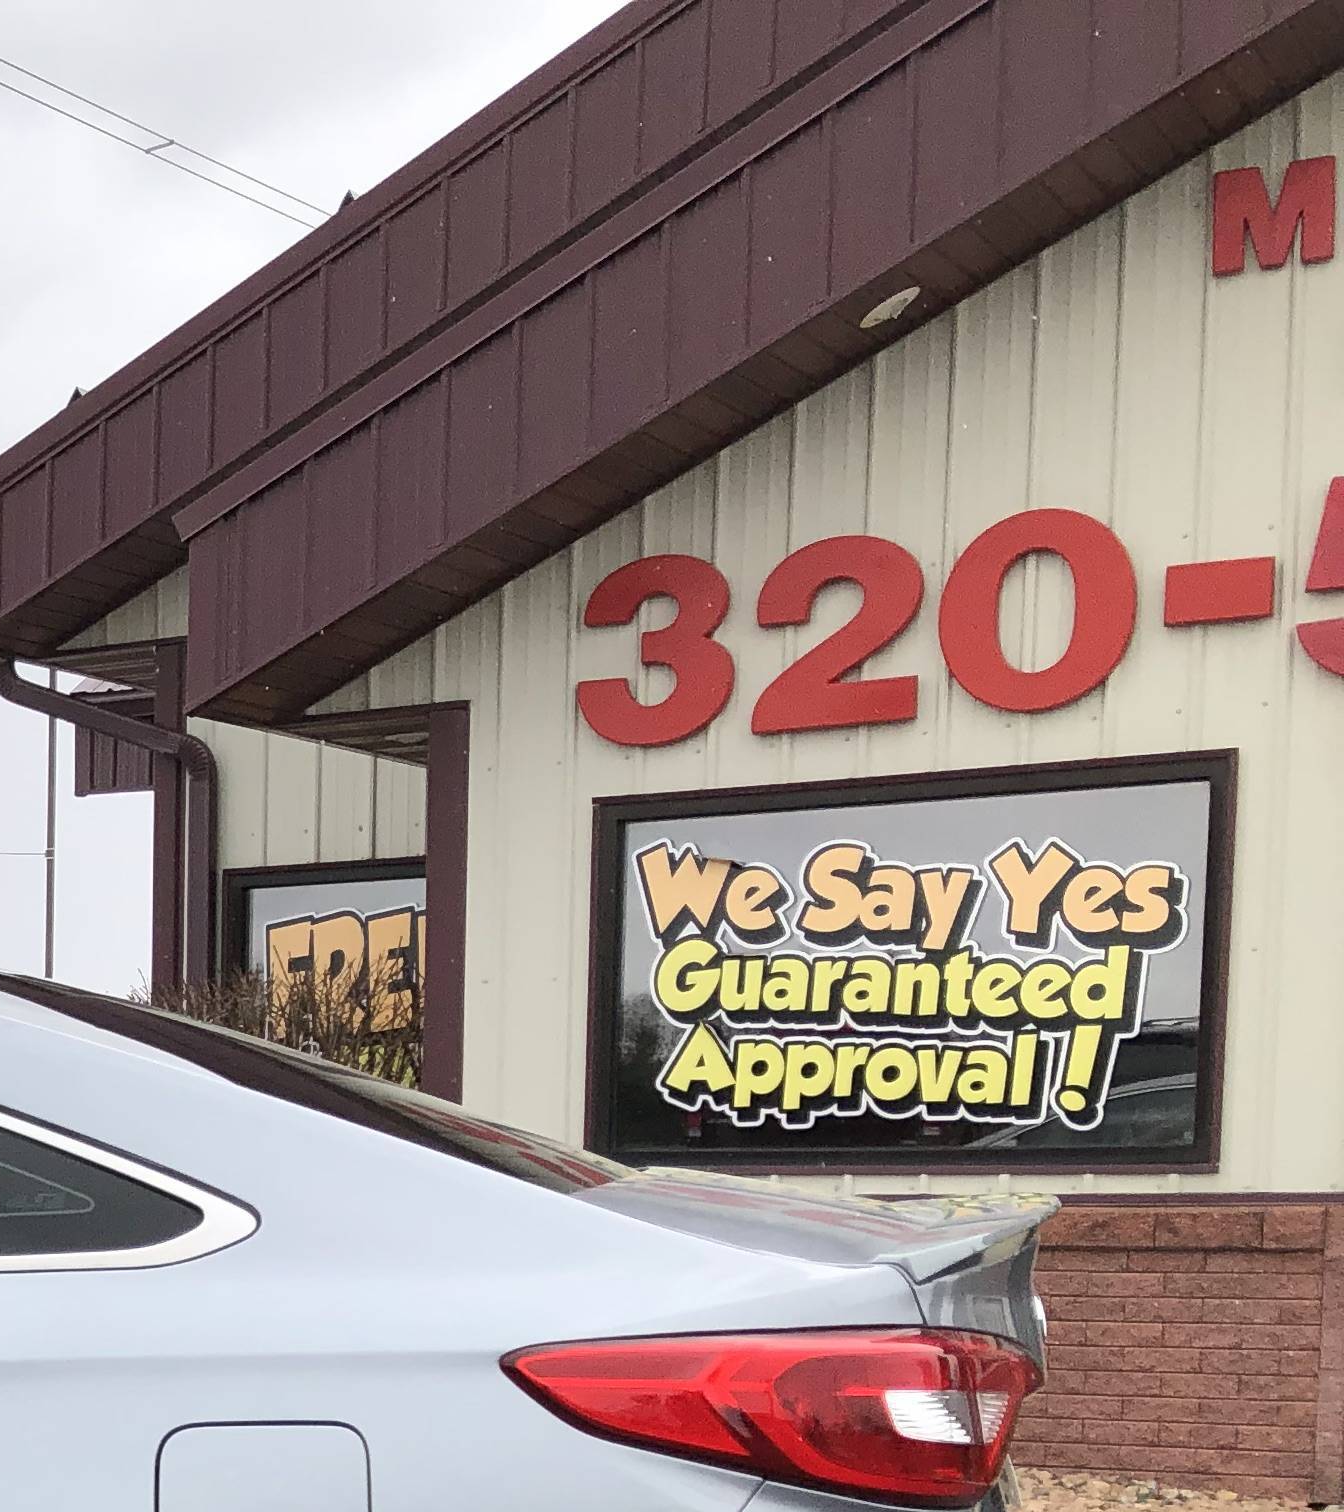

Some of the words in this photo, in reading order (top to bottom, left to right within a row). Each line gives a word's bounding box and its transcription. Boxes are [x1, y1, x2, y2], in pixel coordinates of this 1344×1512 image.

[576, 477, 1344, 748] 320-
[635, 841, 788, 943] We
[800, 841, 982, 951] Say
[988, 839, 1184, 946] Yes
[265, 904, 425, 1037] FRE
[655, 939, 1140, 1028] Guaranteed
